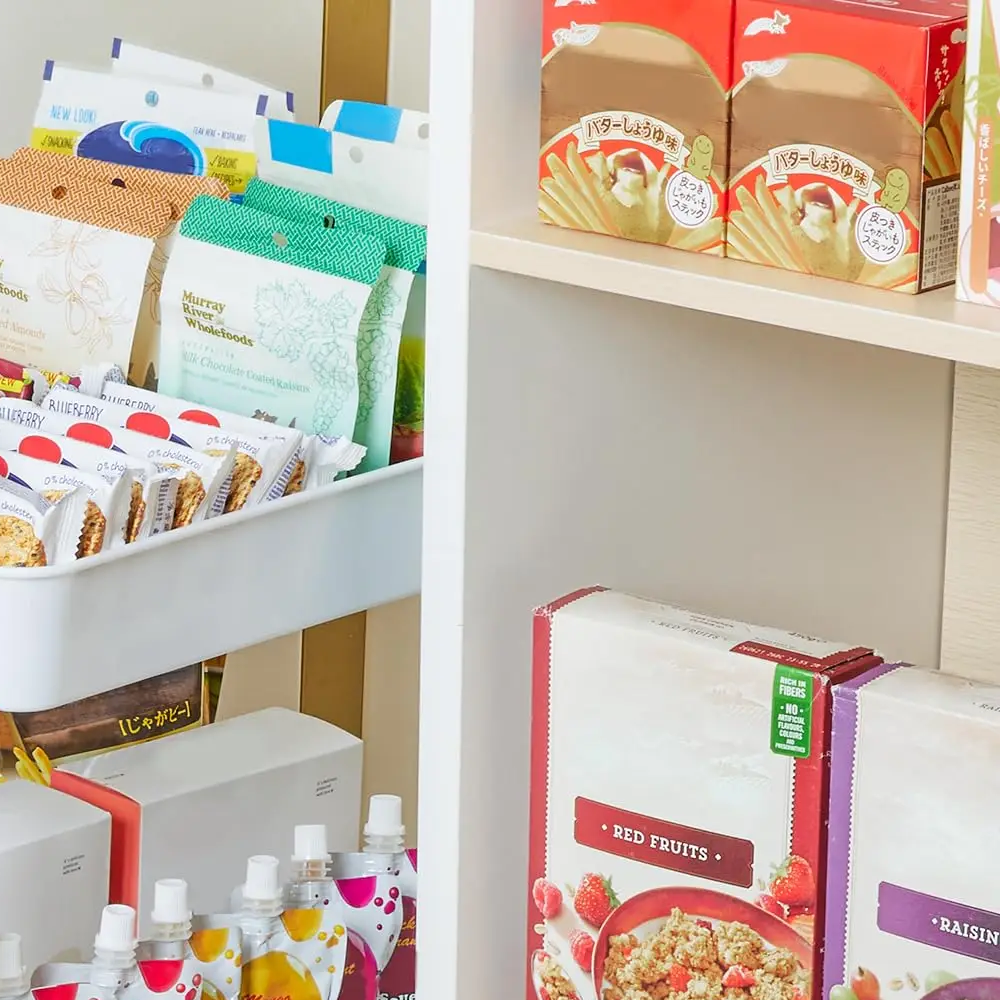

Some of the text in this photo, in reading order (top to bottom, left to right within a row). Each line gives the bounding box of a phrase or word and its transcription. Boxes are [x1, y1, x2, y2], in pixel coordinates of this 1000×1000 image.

[182, 289, 226, 314] Murray
[182, 303, 214, 321] River
[184, 316, 255, 347] Wholefoods
[779, 685, 806, 699] FIBERS
[612, 824, 709, 862] RED FRUITS
